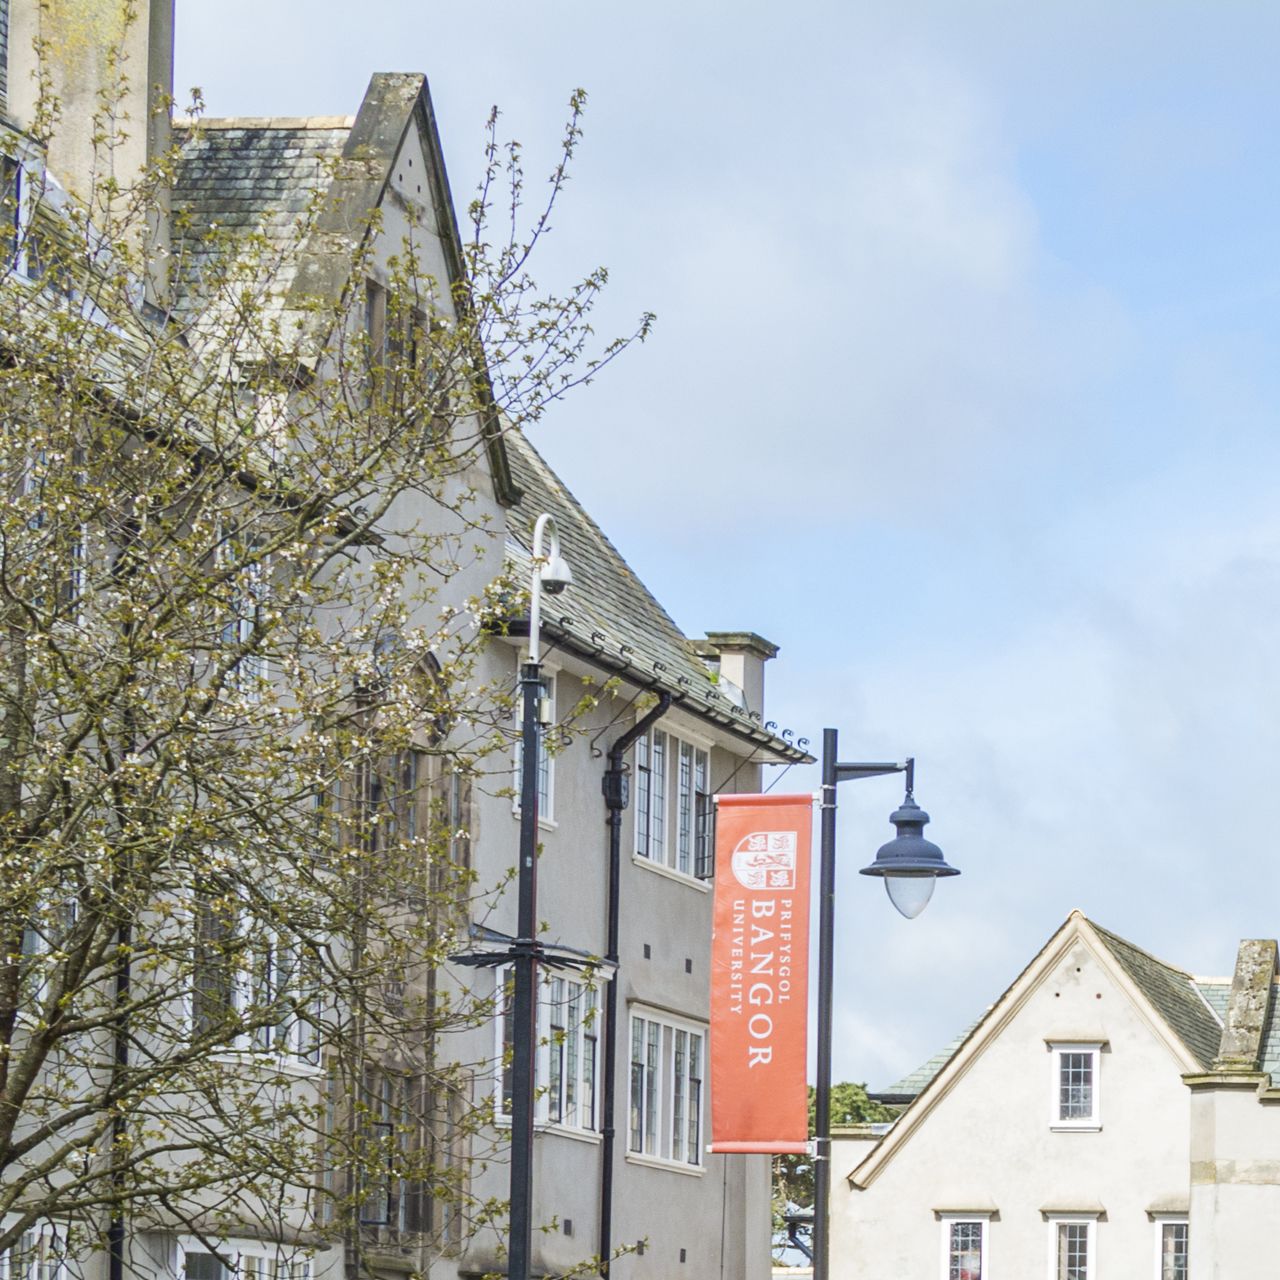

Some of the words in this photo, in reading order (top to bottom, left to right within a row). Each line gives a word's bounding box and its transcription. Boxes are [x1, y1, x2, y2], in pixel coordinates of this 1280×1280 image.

[730, 899, 746, 1015] UNIVERSITY
[748, 899, 776, 1069] BANGOR
[778, 899, 793, 1004] PRIFYSGOL
